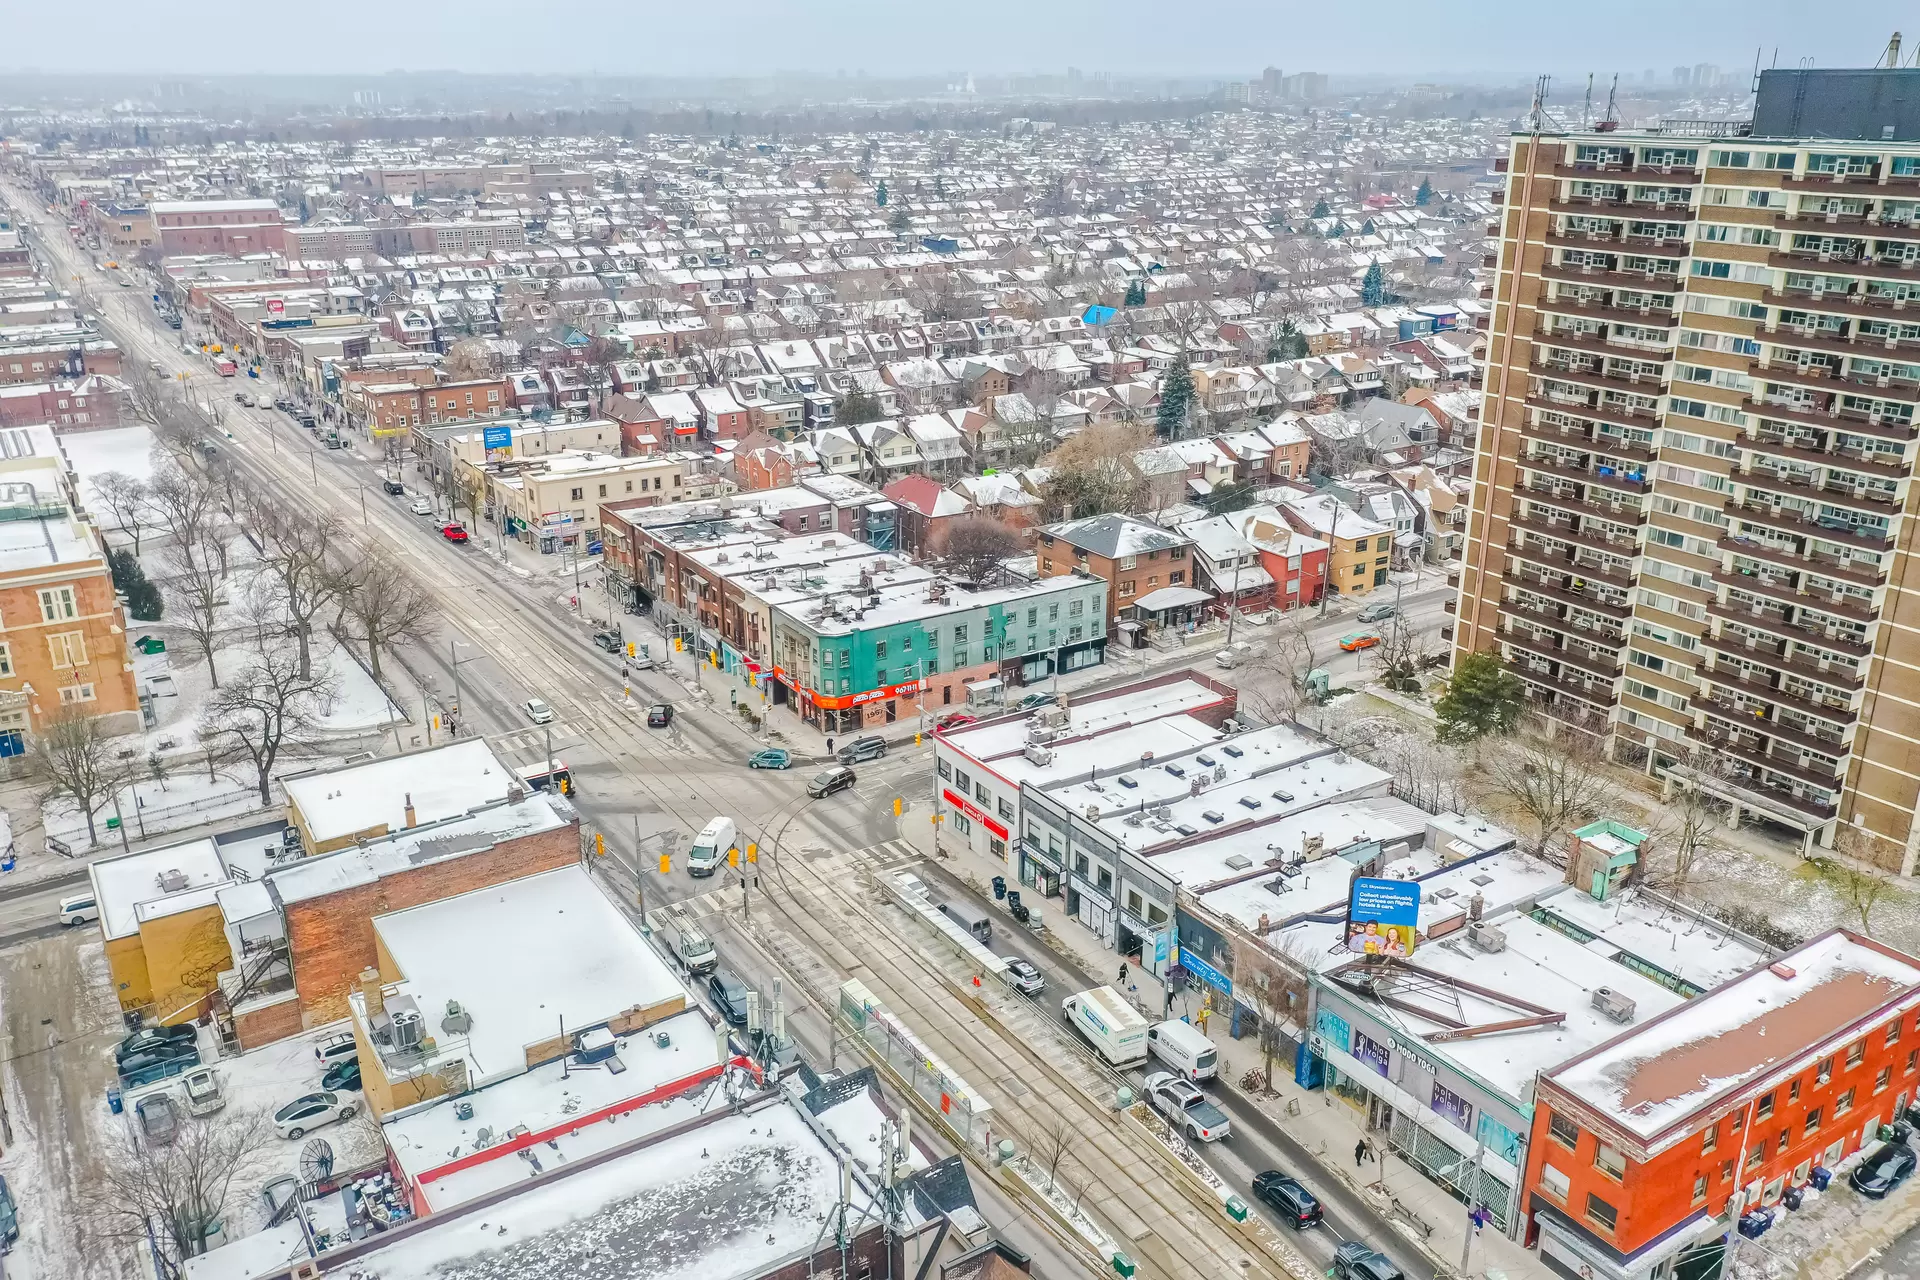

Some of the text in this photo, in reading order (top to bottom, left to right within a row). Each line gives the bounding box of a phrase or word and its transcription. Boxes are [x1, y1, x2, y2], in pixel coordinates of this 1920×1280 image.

[867, 709, 883, 719] 1967
[1359, 891, 1413, 902] Collect unbelievably
[1183, 953, 1207, 977] Beauty
[1208, 972, 1228, 990] Salon
[1328, 1023, 1348, 1040] yoga
[1170, 1044, 1189, 1060] Courier
[1310, 1040, 1324, 1053] MODO
[1372, 1041, 1389, 1058] hot
[1366, 1048, 1388, 1067] yoga
[1396, 1043, 1437, 1076] MODO YOGA
[1434, 1083, 1452, 1100] hot
[1434, 1092, 1457, 1112] yoga
